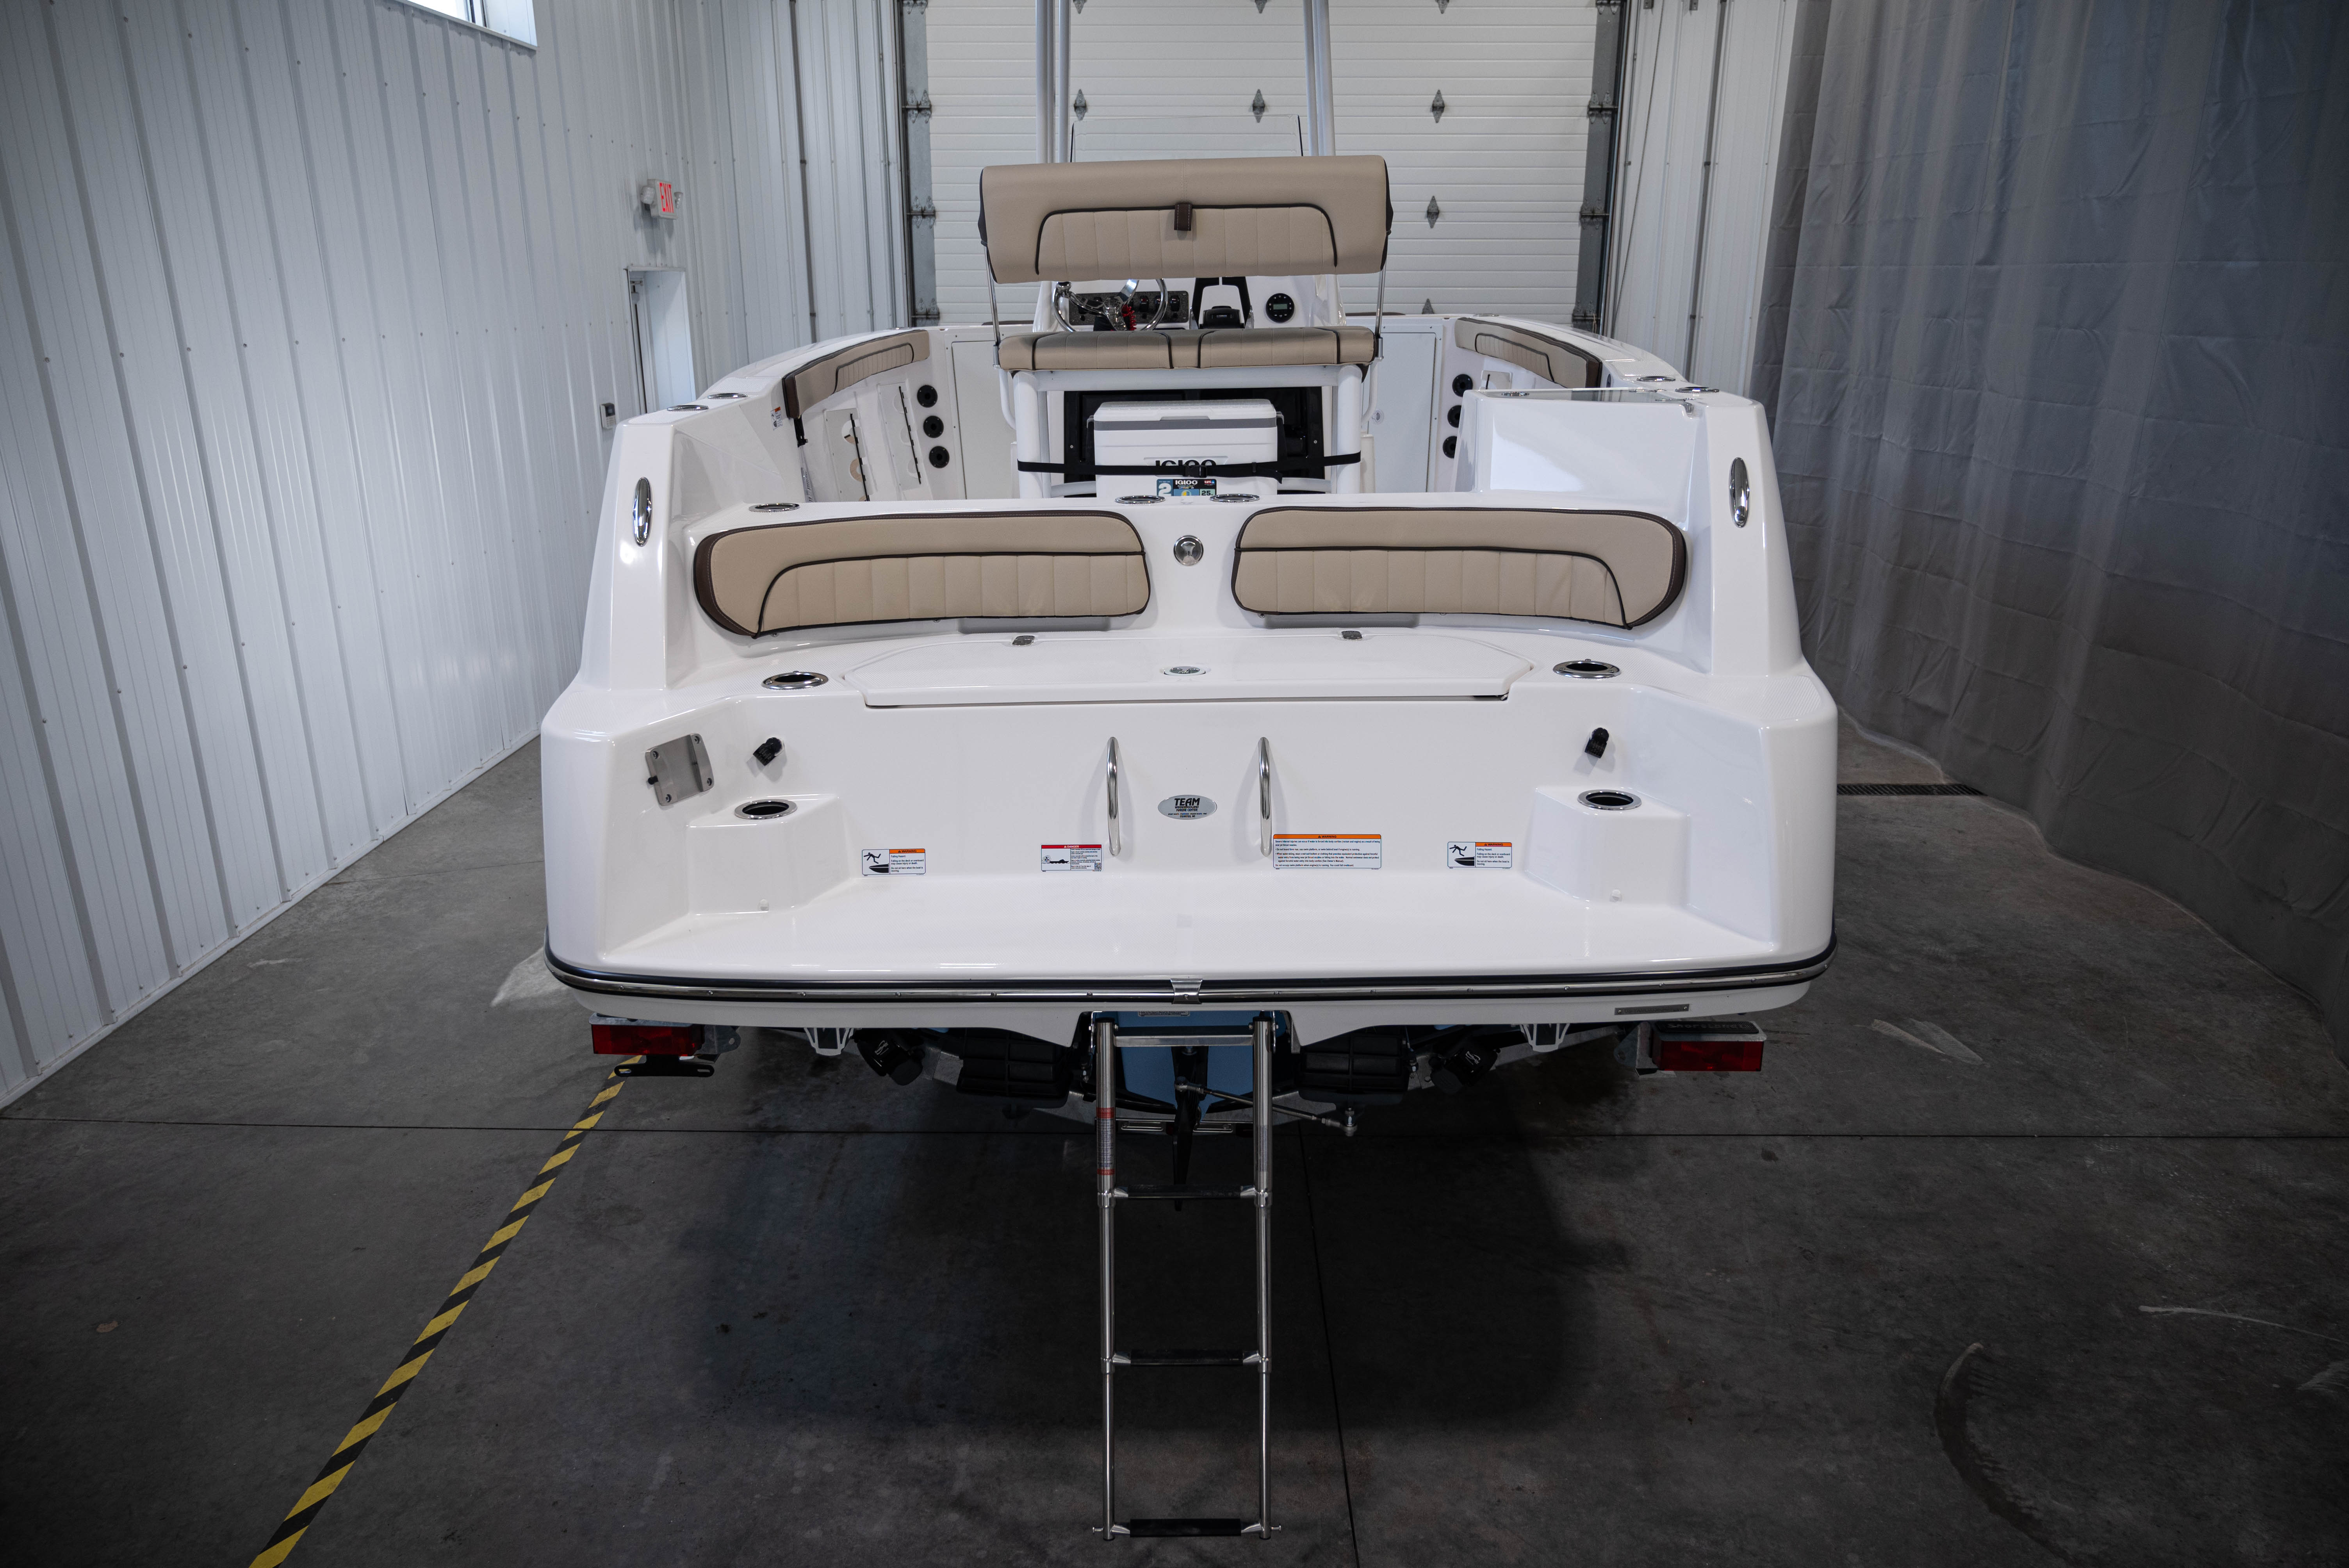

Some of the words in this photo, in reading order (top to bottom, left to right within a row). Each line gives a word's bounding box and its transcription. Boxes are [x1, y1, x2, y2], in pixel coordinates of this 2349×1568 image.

[659, 183, 674, 213] EXIT
[1158, 483, 1171, 496] 2
[1174, 798, 1200, 807] TEAM
